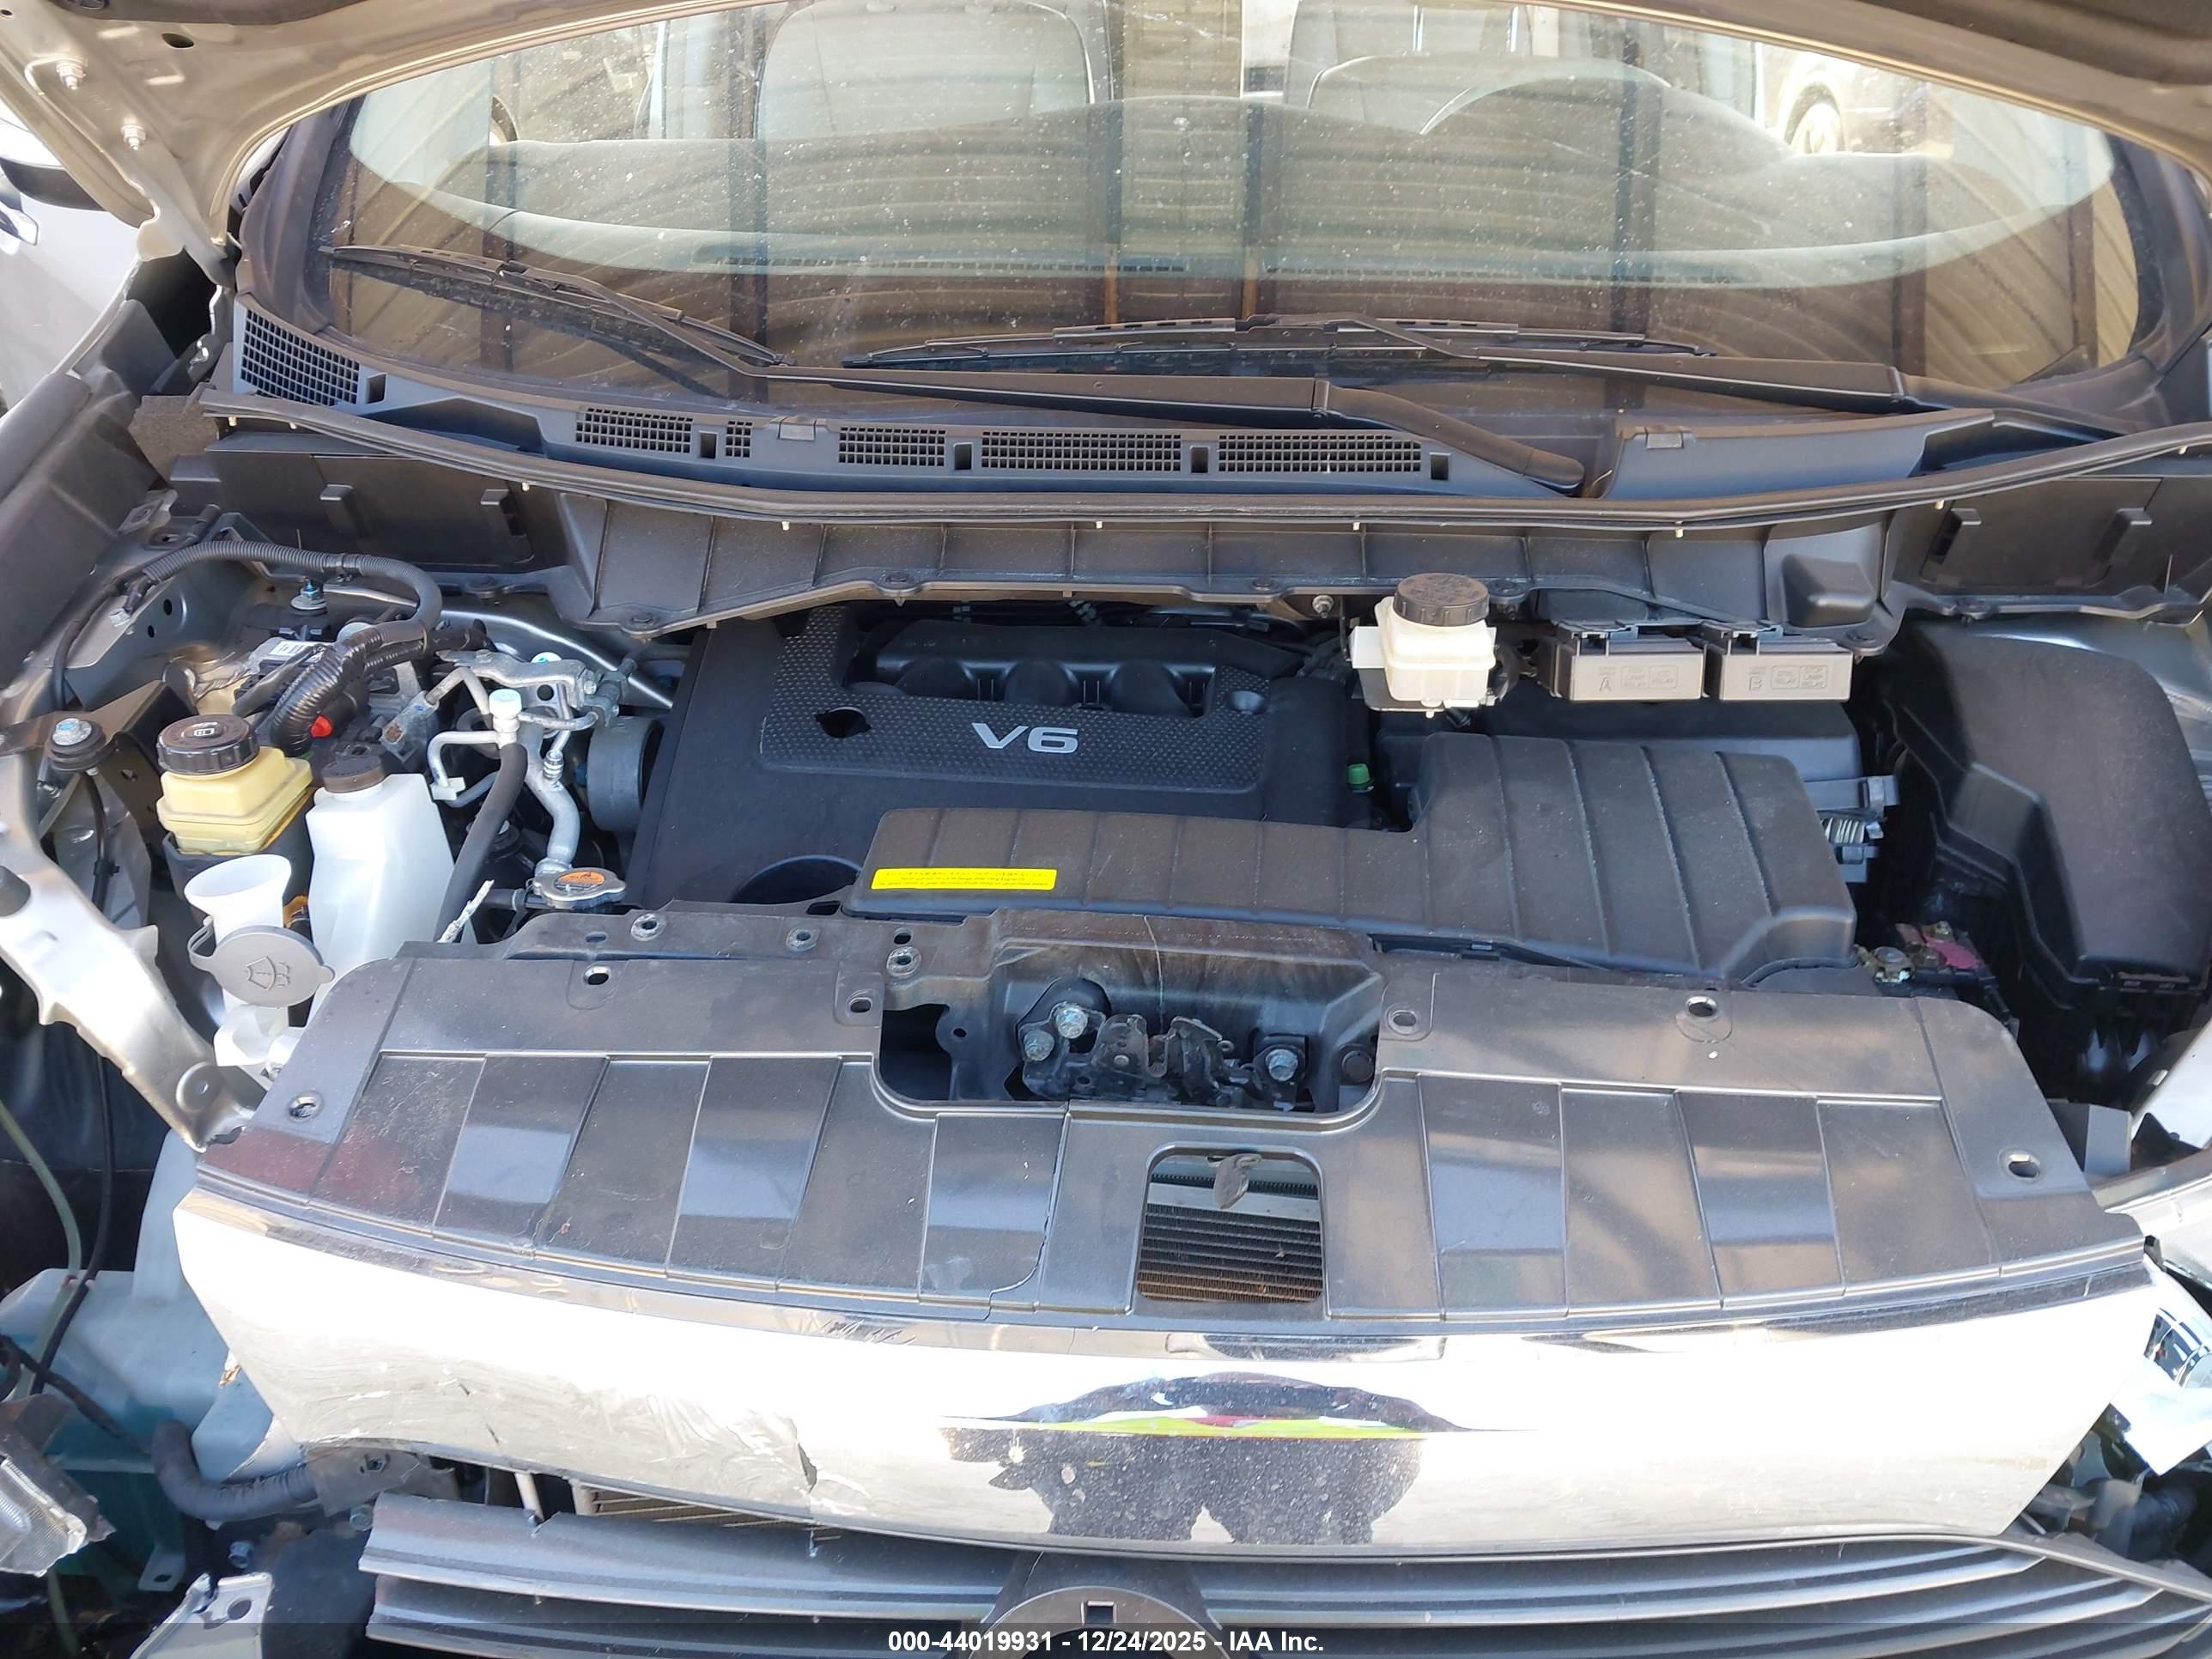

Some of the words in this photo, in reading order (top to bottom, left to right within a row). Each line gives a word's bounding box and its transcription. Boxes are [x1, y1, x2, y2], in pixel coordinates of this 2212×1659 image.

[1599, 676, 1612, 691] A
[1749, 676, 1762, 691] B
[971, 722, 1078, 754] V6
